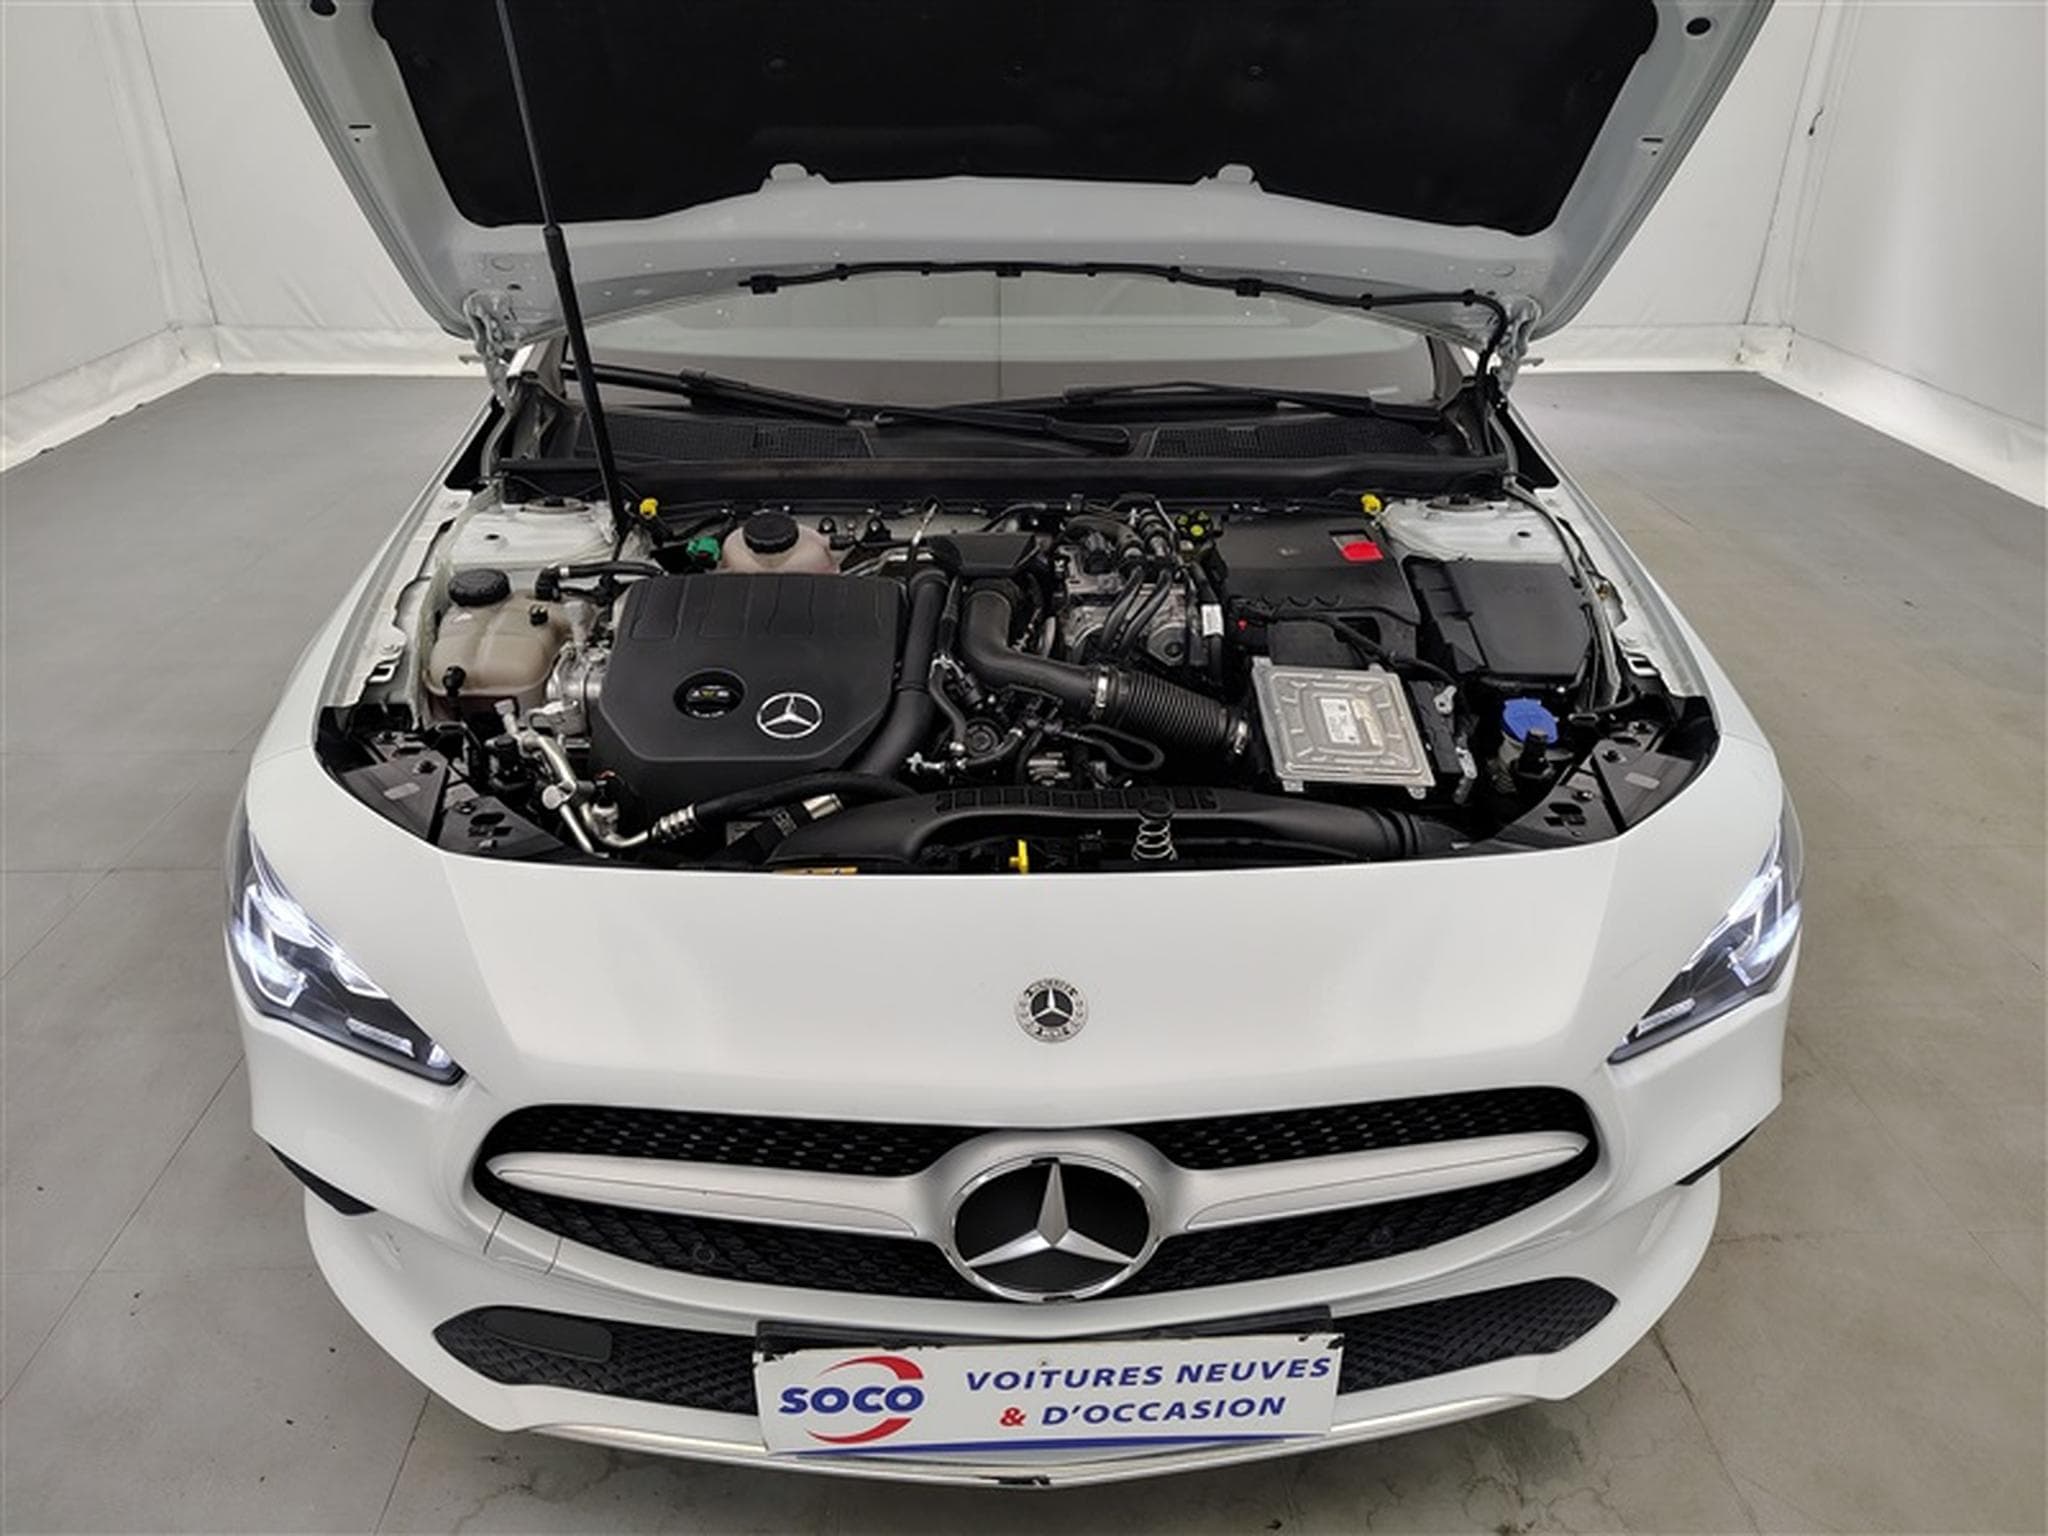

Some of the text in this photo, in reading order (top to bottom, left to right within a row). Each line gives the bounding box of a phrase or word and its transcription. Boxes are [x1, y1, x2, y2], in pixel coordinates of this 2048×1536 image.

[966, 1356, 1331, 1391] VOITURES NEUVES
[779, 1386, 925, 1414] SOCO
[999, 1396, 1287, 1427] & D'OCCASION
